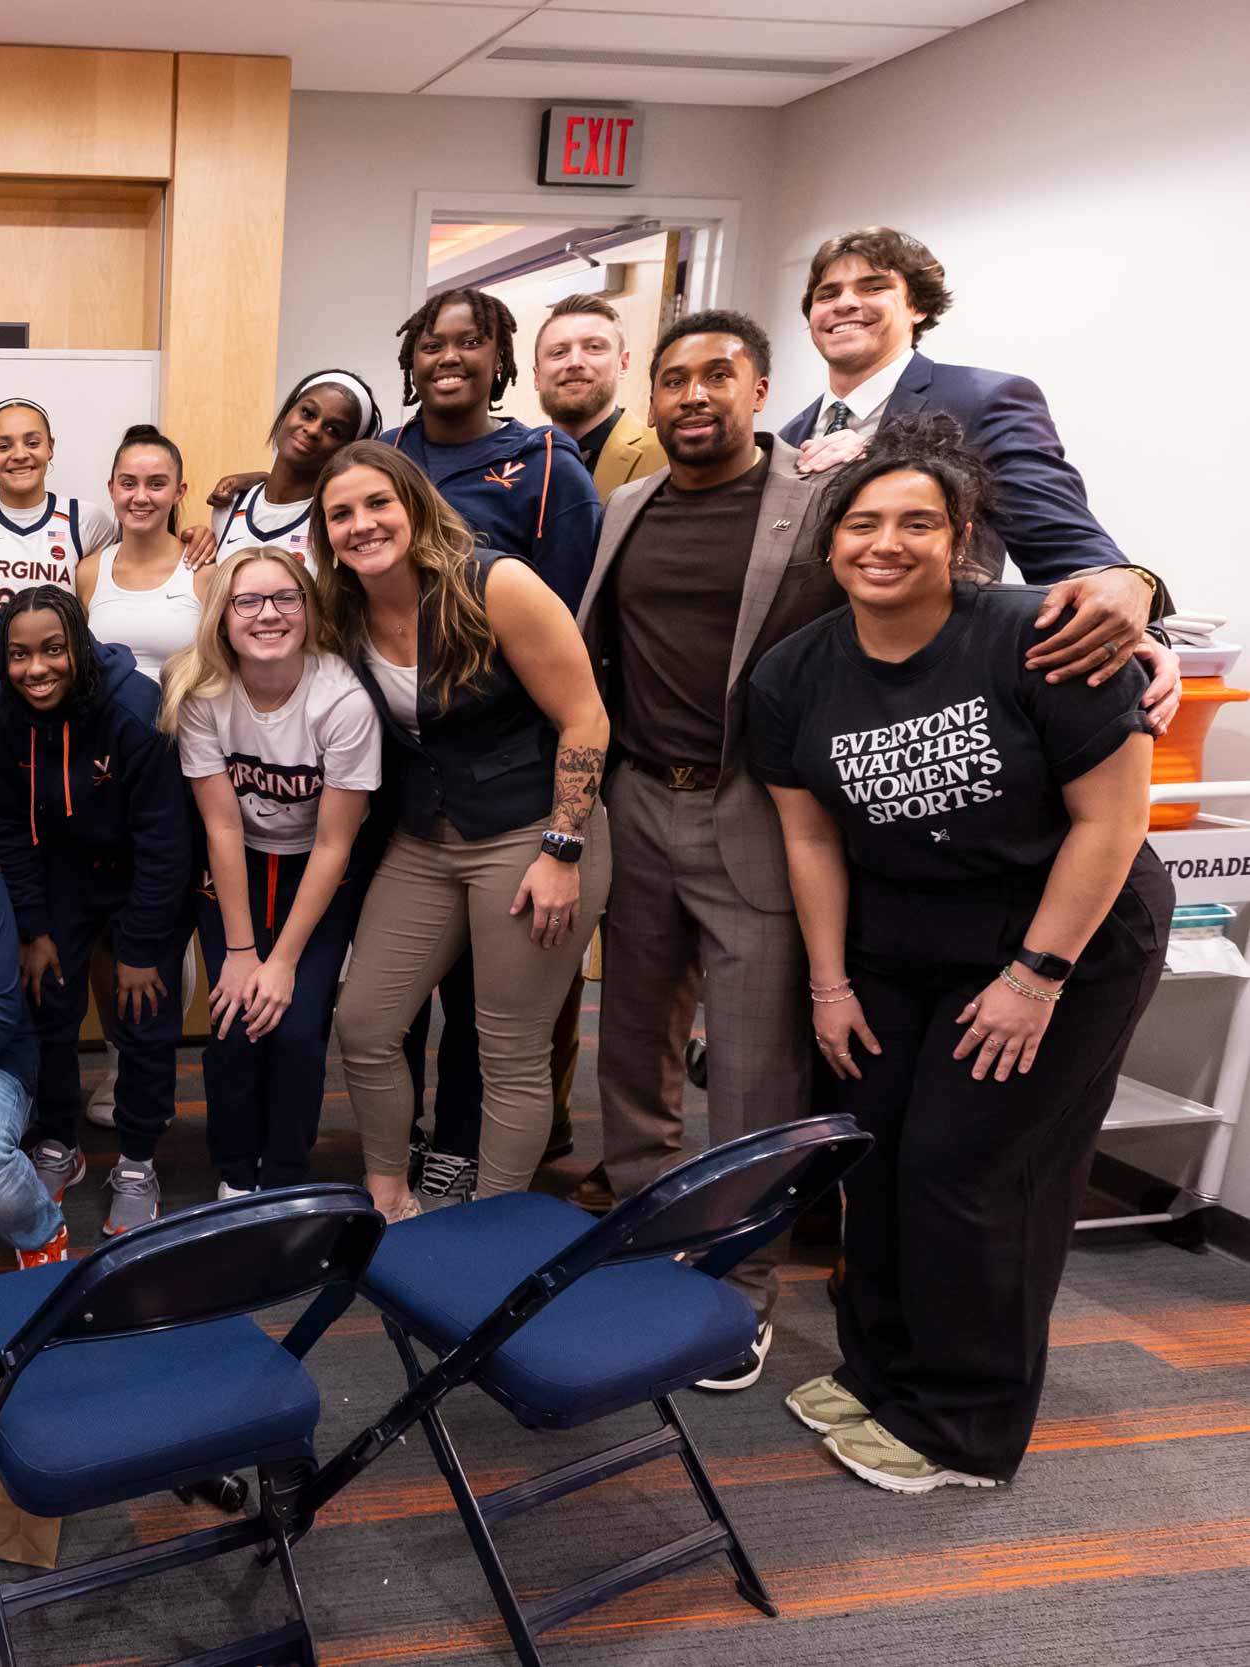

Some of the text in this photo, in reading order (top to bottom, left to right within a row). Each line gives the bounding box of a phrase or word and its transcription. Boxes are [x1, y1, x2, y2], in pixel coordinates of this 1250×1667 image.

[562, 116, 634, 176] EXIT
[830, 696, 988, 759] EVERYONE
[836, 723, 991, 781] WATCHES
[841, 749, 1002, 804] WOMEN'S
[867, 779, 1003, 824] SPORTS.
